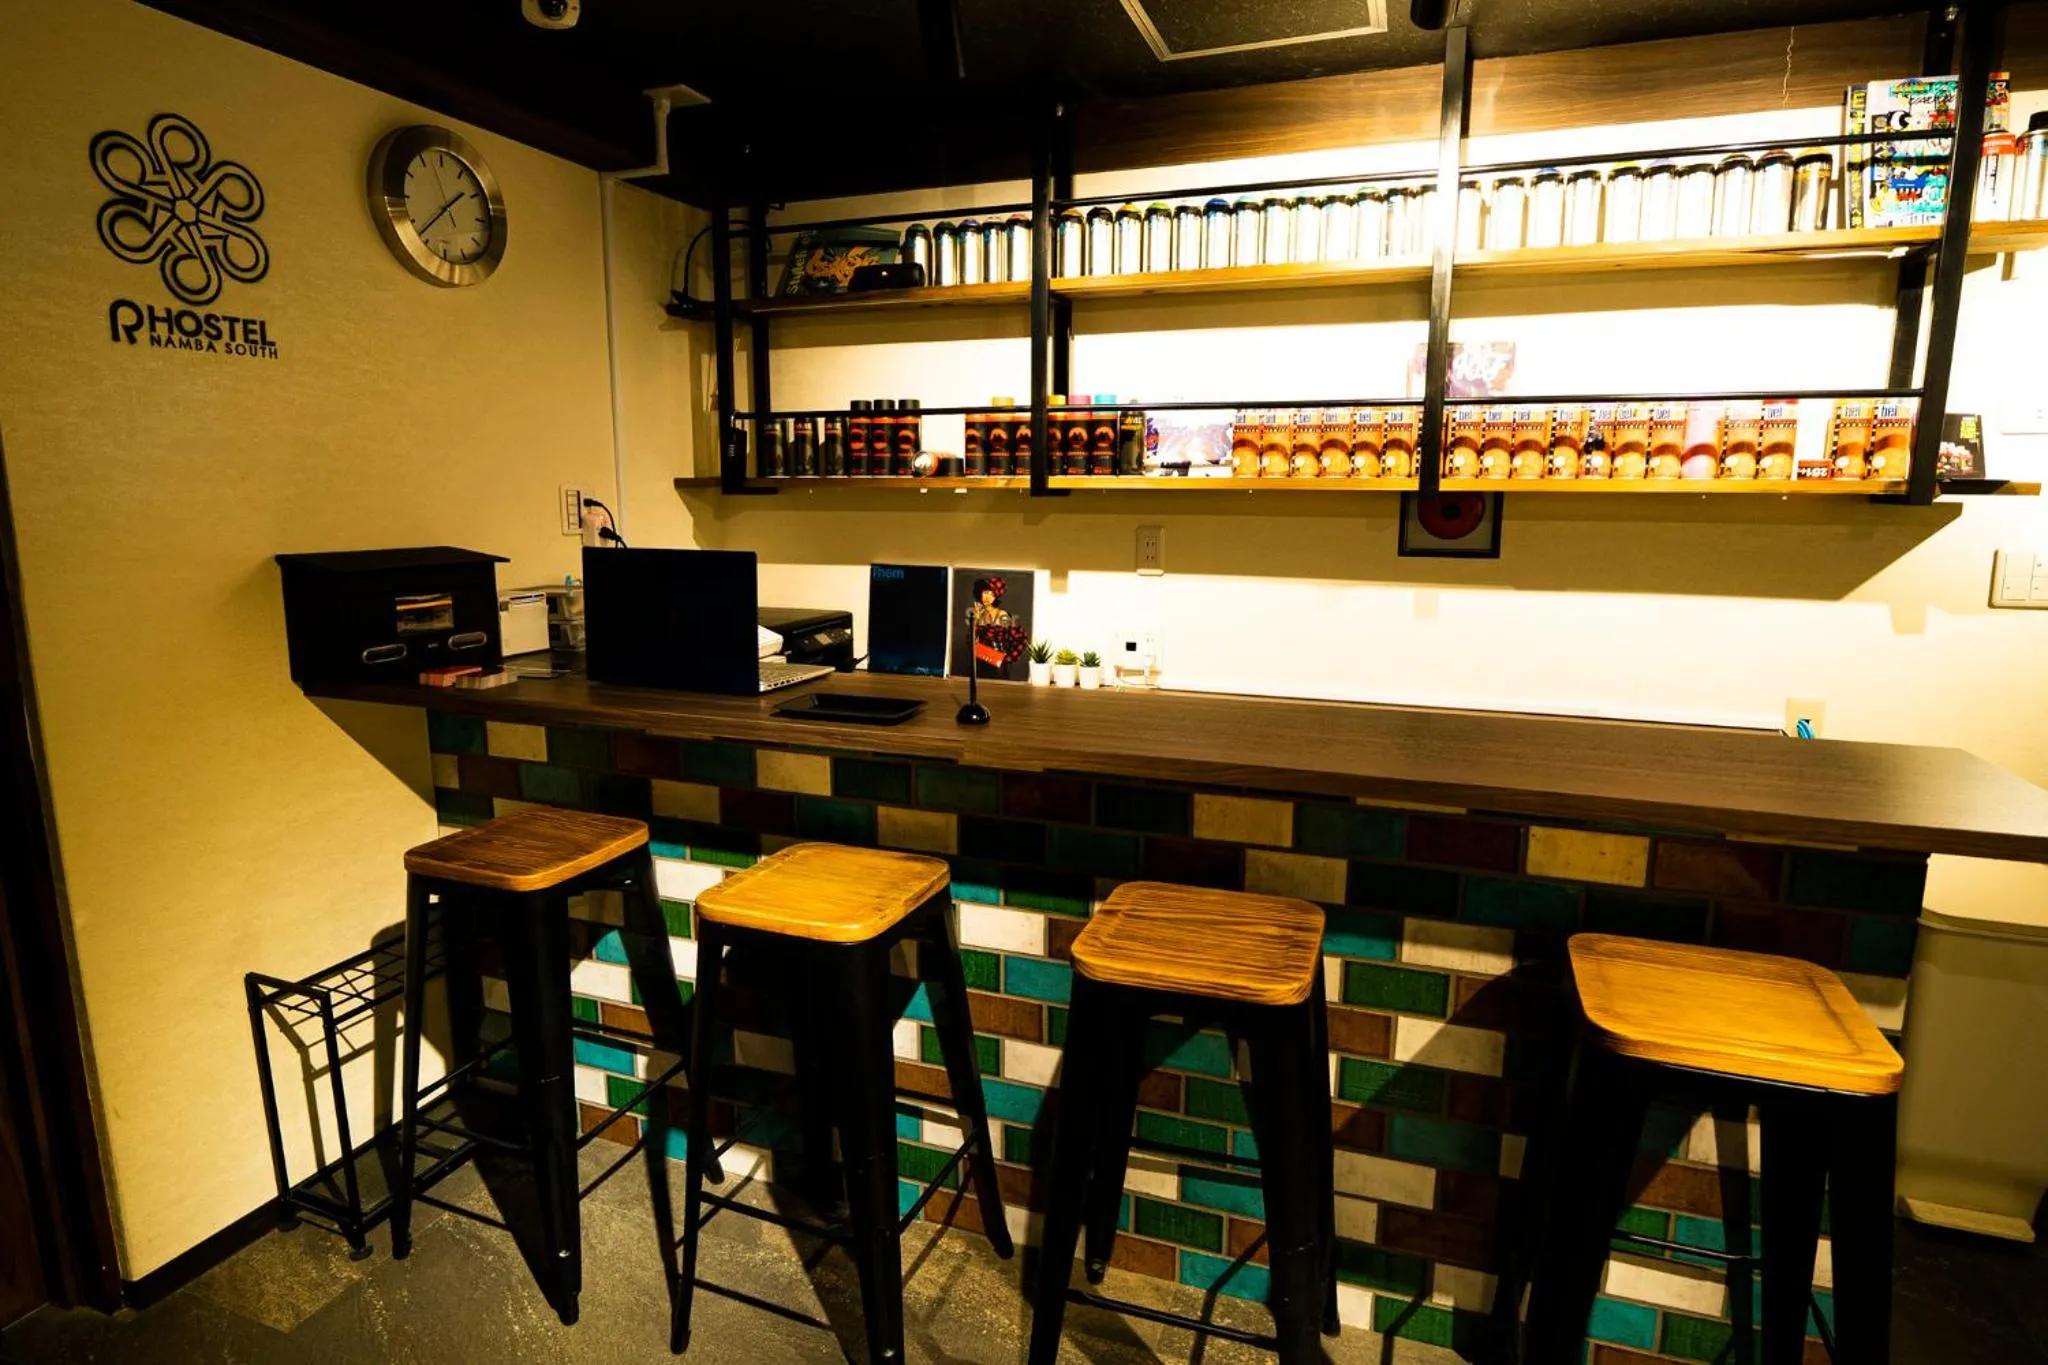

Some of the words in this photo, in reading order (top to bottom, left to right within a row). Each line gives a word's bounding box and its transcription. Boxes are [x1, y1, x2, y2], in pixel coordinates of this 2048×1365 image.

[147, 303, 276, 347] HOSTEL
[150, 334, 218, 353] NAMBA
[224, 343, 278, 359] SOUTH
